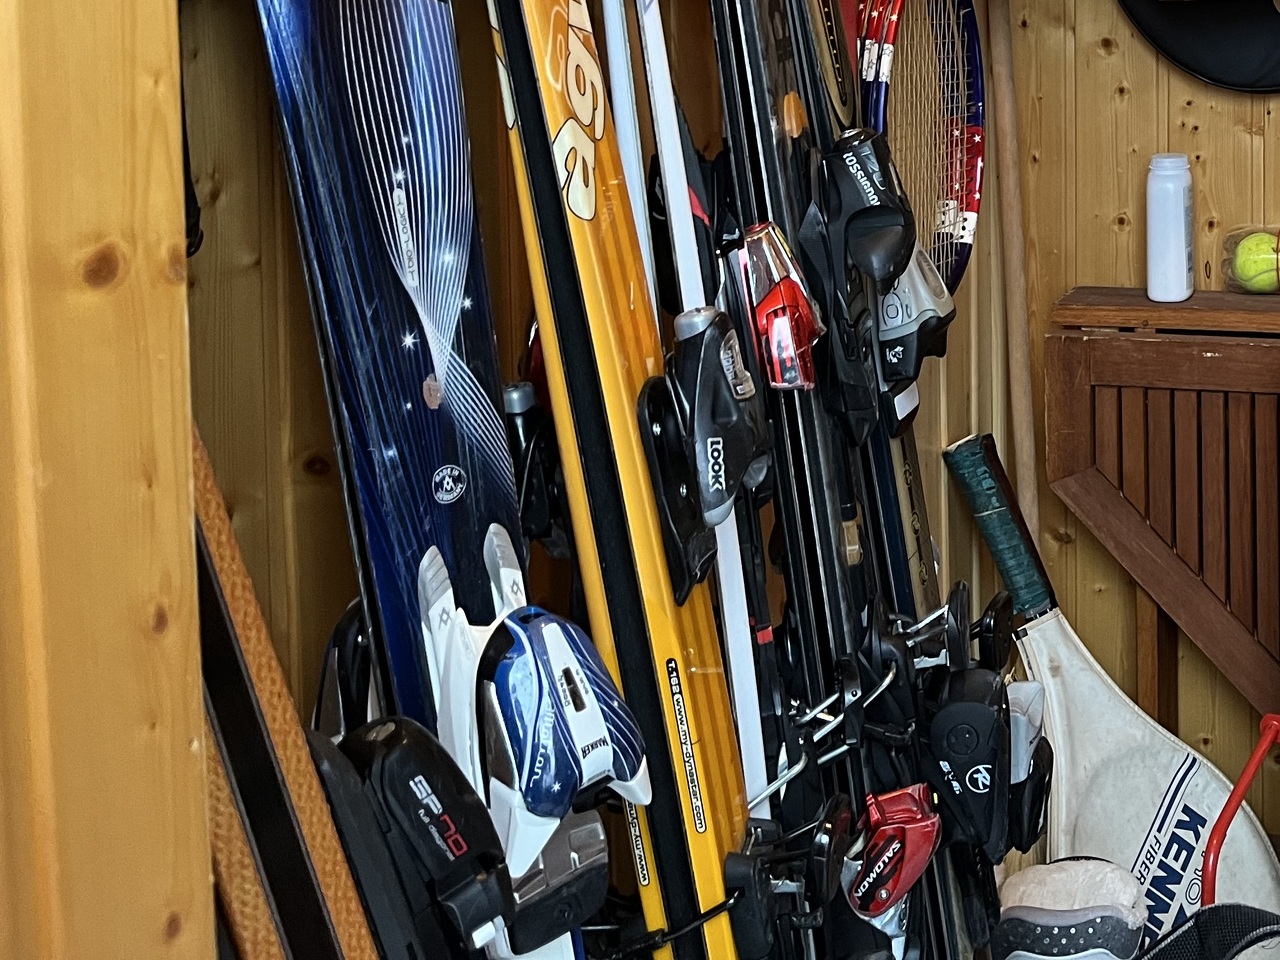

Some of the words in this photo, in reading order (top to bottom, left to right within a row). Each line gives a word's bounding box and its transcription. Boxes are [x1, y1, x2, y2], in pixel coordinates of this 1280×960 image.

[706, 436, 728, 493] LOOK
[582, 734, 608, 760] MARKER
[673, 697, 706, 830] www.my-dynastar.com
[854, 839, 902, 897] SALOMON
